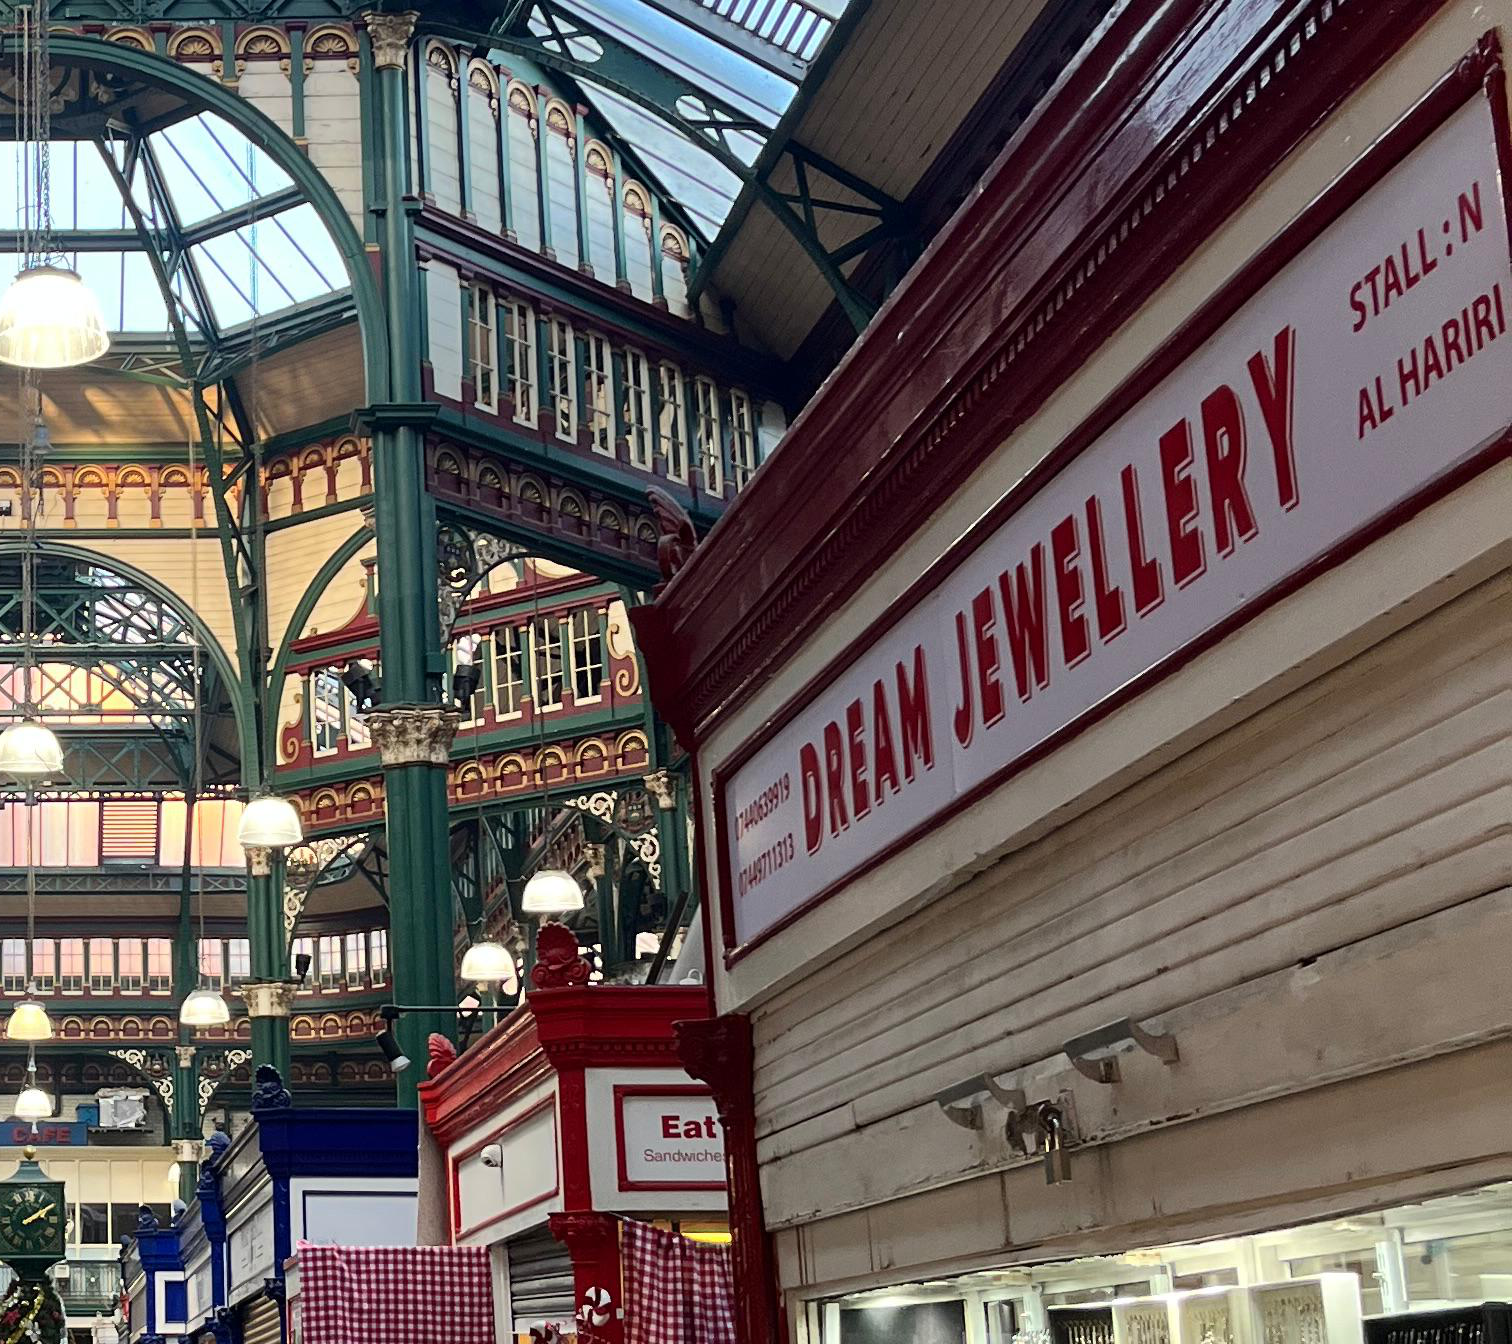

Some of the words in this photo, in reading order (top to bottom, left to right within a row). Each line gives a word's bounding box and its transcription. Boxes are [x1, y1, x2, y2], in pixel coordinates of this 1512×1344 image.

[1358, 375, 1394, 440] AL
[1397, 282, 1507, 407] HARIRI
[799, 644, 935, 857] DREAM
[953, 323, 1300, 749] JEWELLERY
[660, 1115, 718, 1139] Eat
